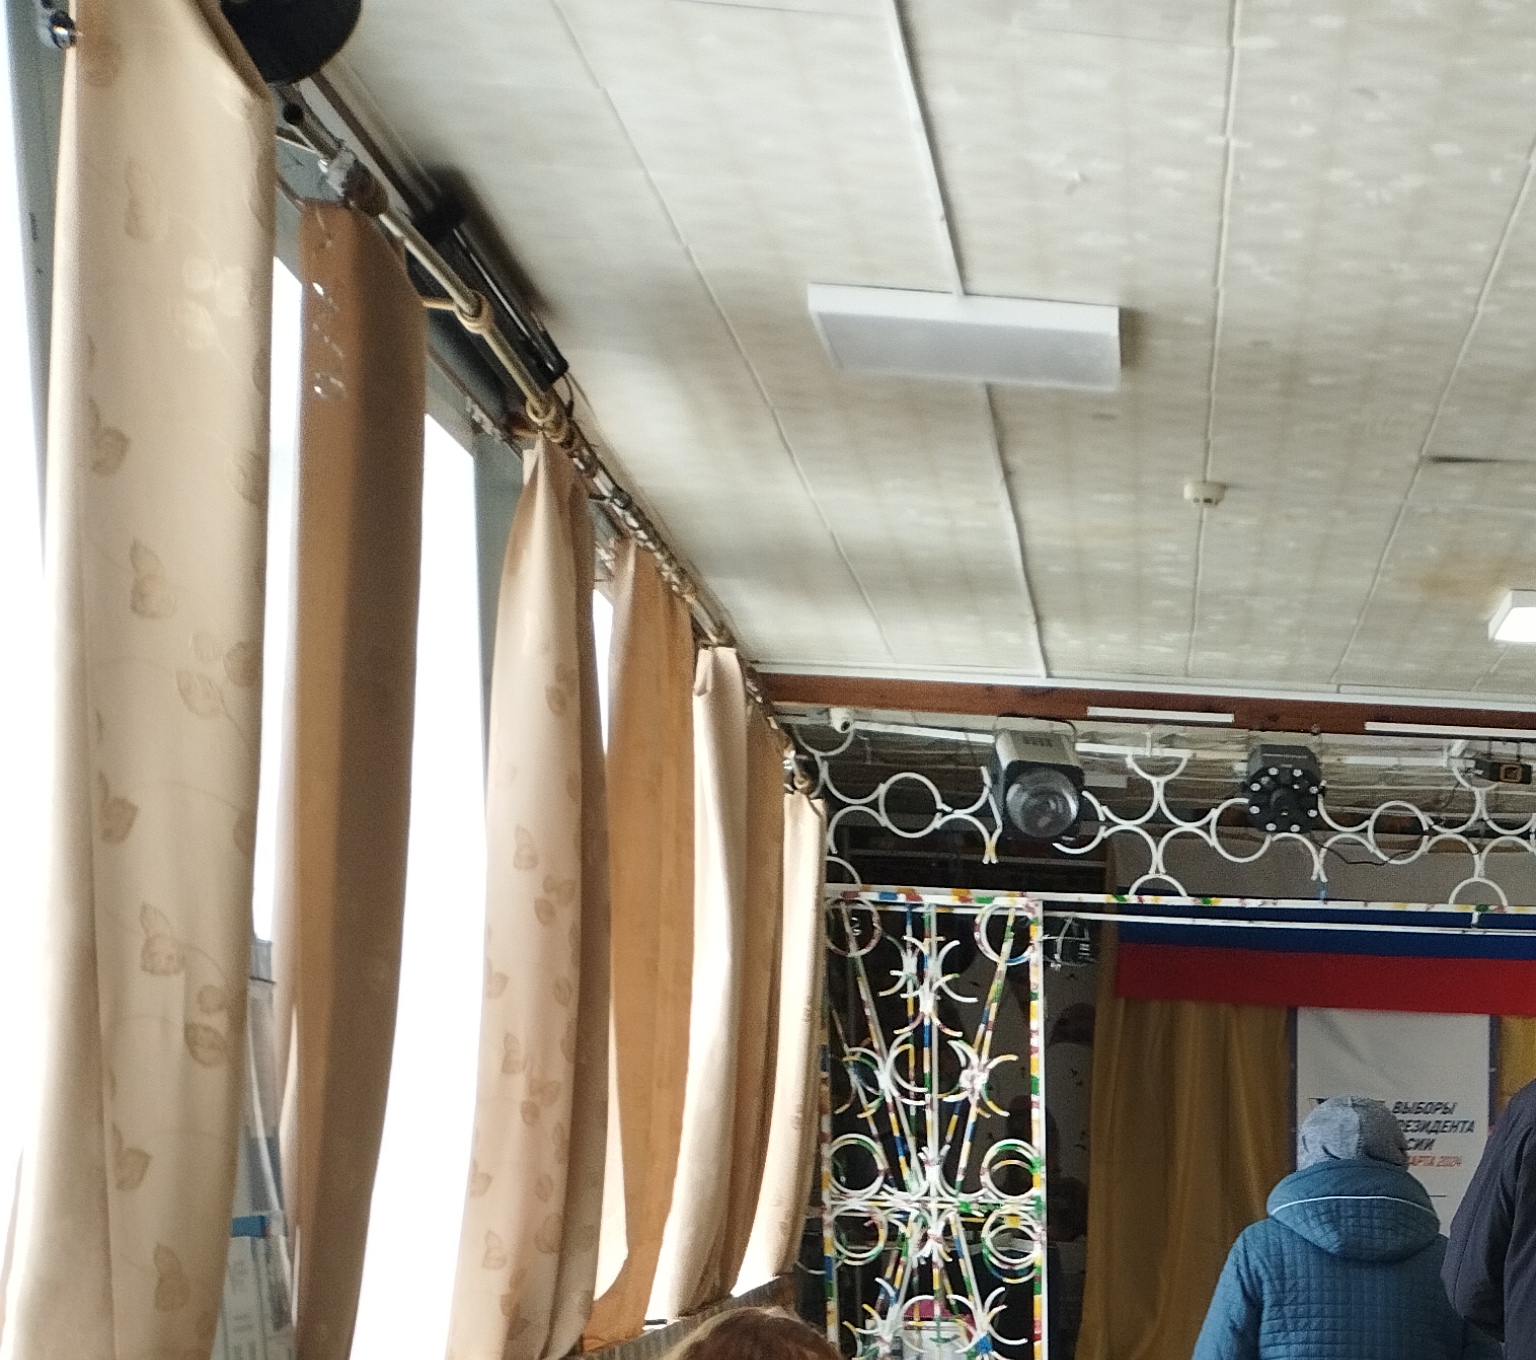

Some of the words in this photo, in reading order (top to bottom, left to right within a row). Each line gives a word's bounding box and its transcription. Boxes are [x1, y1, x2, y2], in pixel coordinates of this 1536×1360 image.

[1392, 1101, 1458, 1114] ВЫБОРЫ
[1398, 1120, 1475, 1134] РЕЗИДЕНТА
[1406, 1138, 1436, 1150] СИИ
